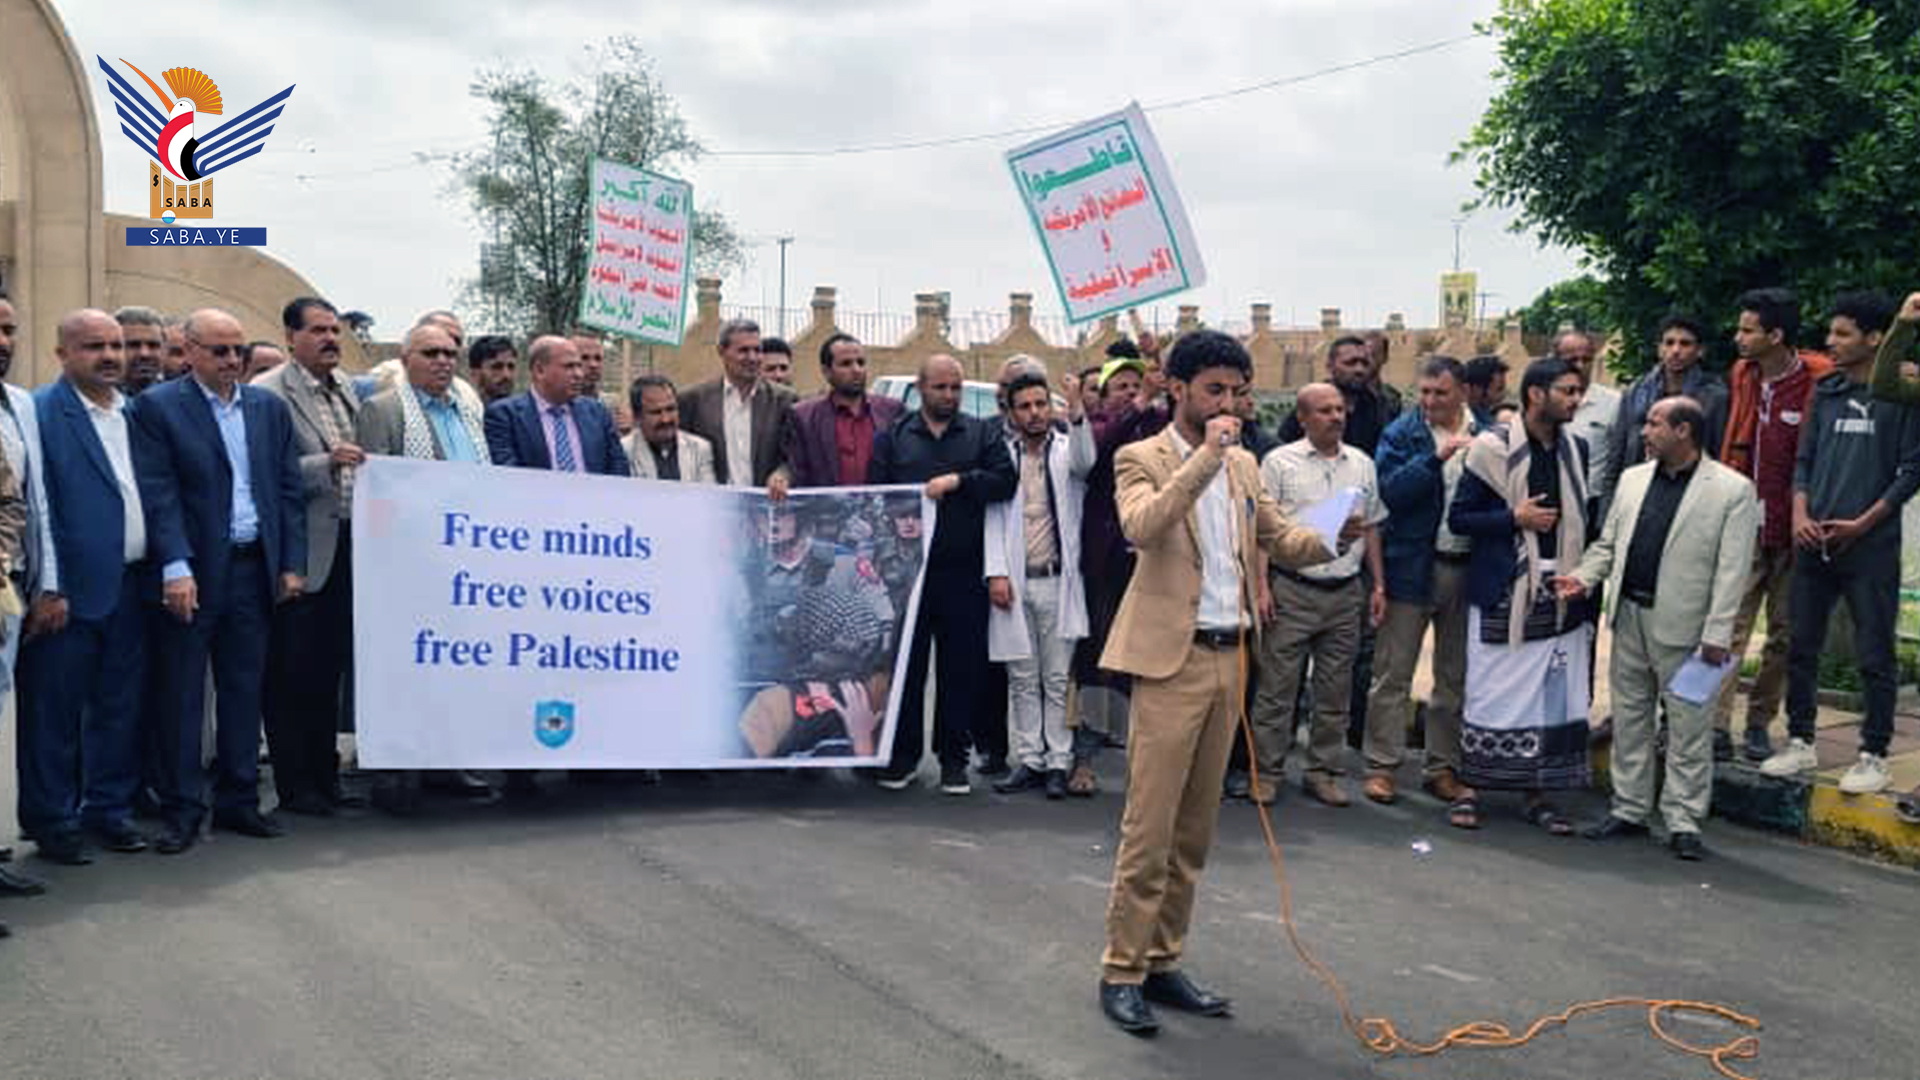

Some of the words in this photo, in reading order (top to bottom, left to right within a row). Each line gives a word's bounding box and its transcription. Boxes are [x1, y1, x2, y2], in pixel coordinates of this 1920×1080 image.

[1022, 135, 1133, 202] قاطعوا
[655, 187, 688, 216] الله
[441, 512, 530, 552] Free
[542, 522, 652, 559] minds
[450, 572, 527, 609] free
[540, 580, 652, 616] voices
[413, 629, 493, 666] free
[508, 632, 680, 672] Palestine
